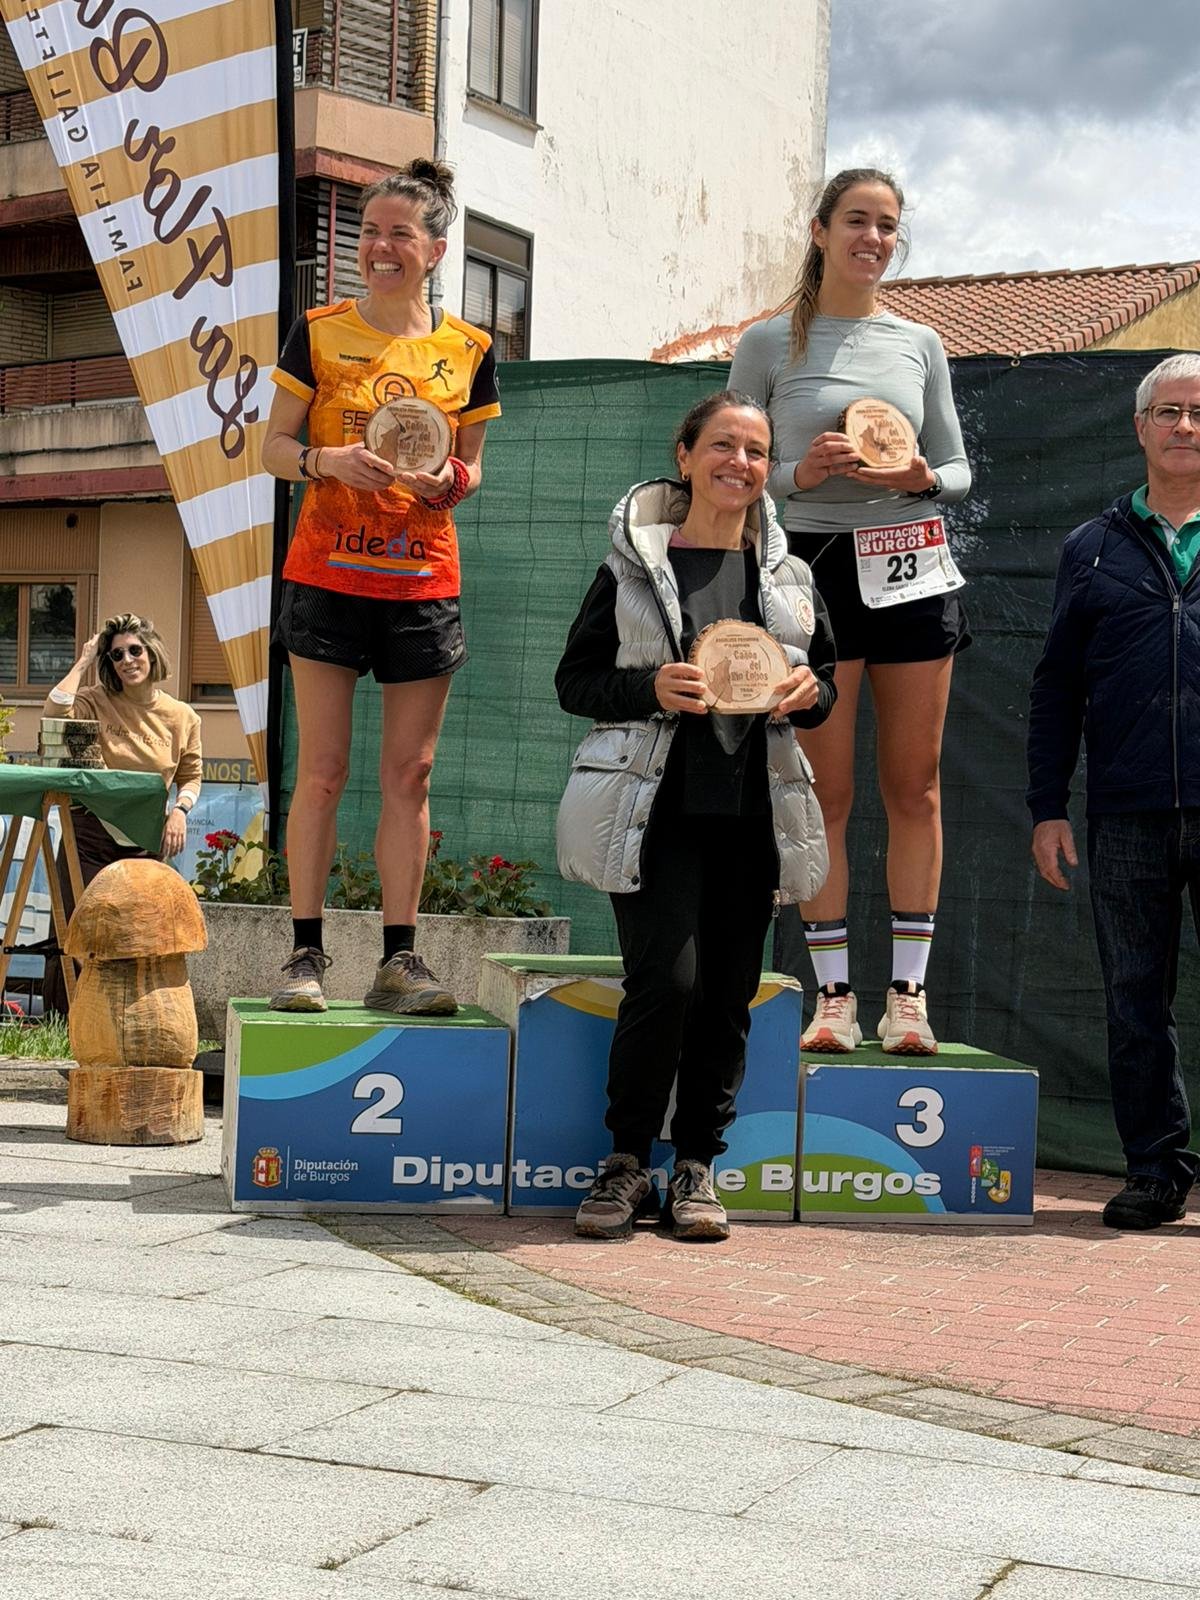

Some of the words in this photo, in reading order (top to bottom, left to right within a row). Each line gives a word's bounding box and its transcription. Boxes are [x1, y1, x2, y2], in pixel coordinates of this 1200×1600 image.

[342, 409, 369, 427] SE
[335, 523, 427, 561] ideda
[858, 524, 925, 543] DIPUTACIÓN
[860, 534, 926, 555] BURGOS
[887, 552, 917, 583] 23
[202, 763, 240, 781] NOS
[350, 1072, 405, 1134] 2
[895, 1086, 945, 1148] 3
[294, 1159, 359, 1173] Diputación
[293, 1171, 307, 1182] de
[309, 1171, 351, 1185] Burgos
[392, 1155, 669, 1192] Diputacin
[760, 1163, 942, 1200] Burgos
